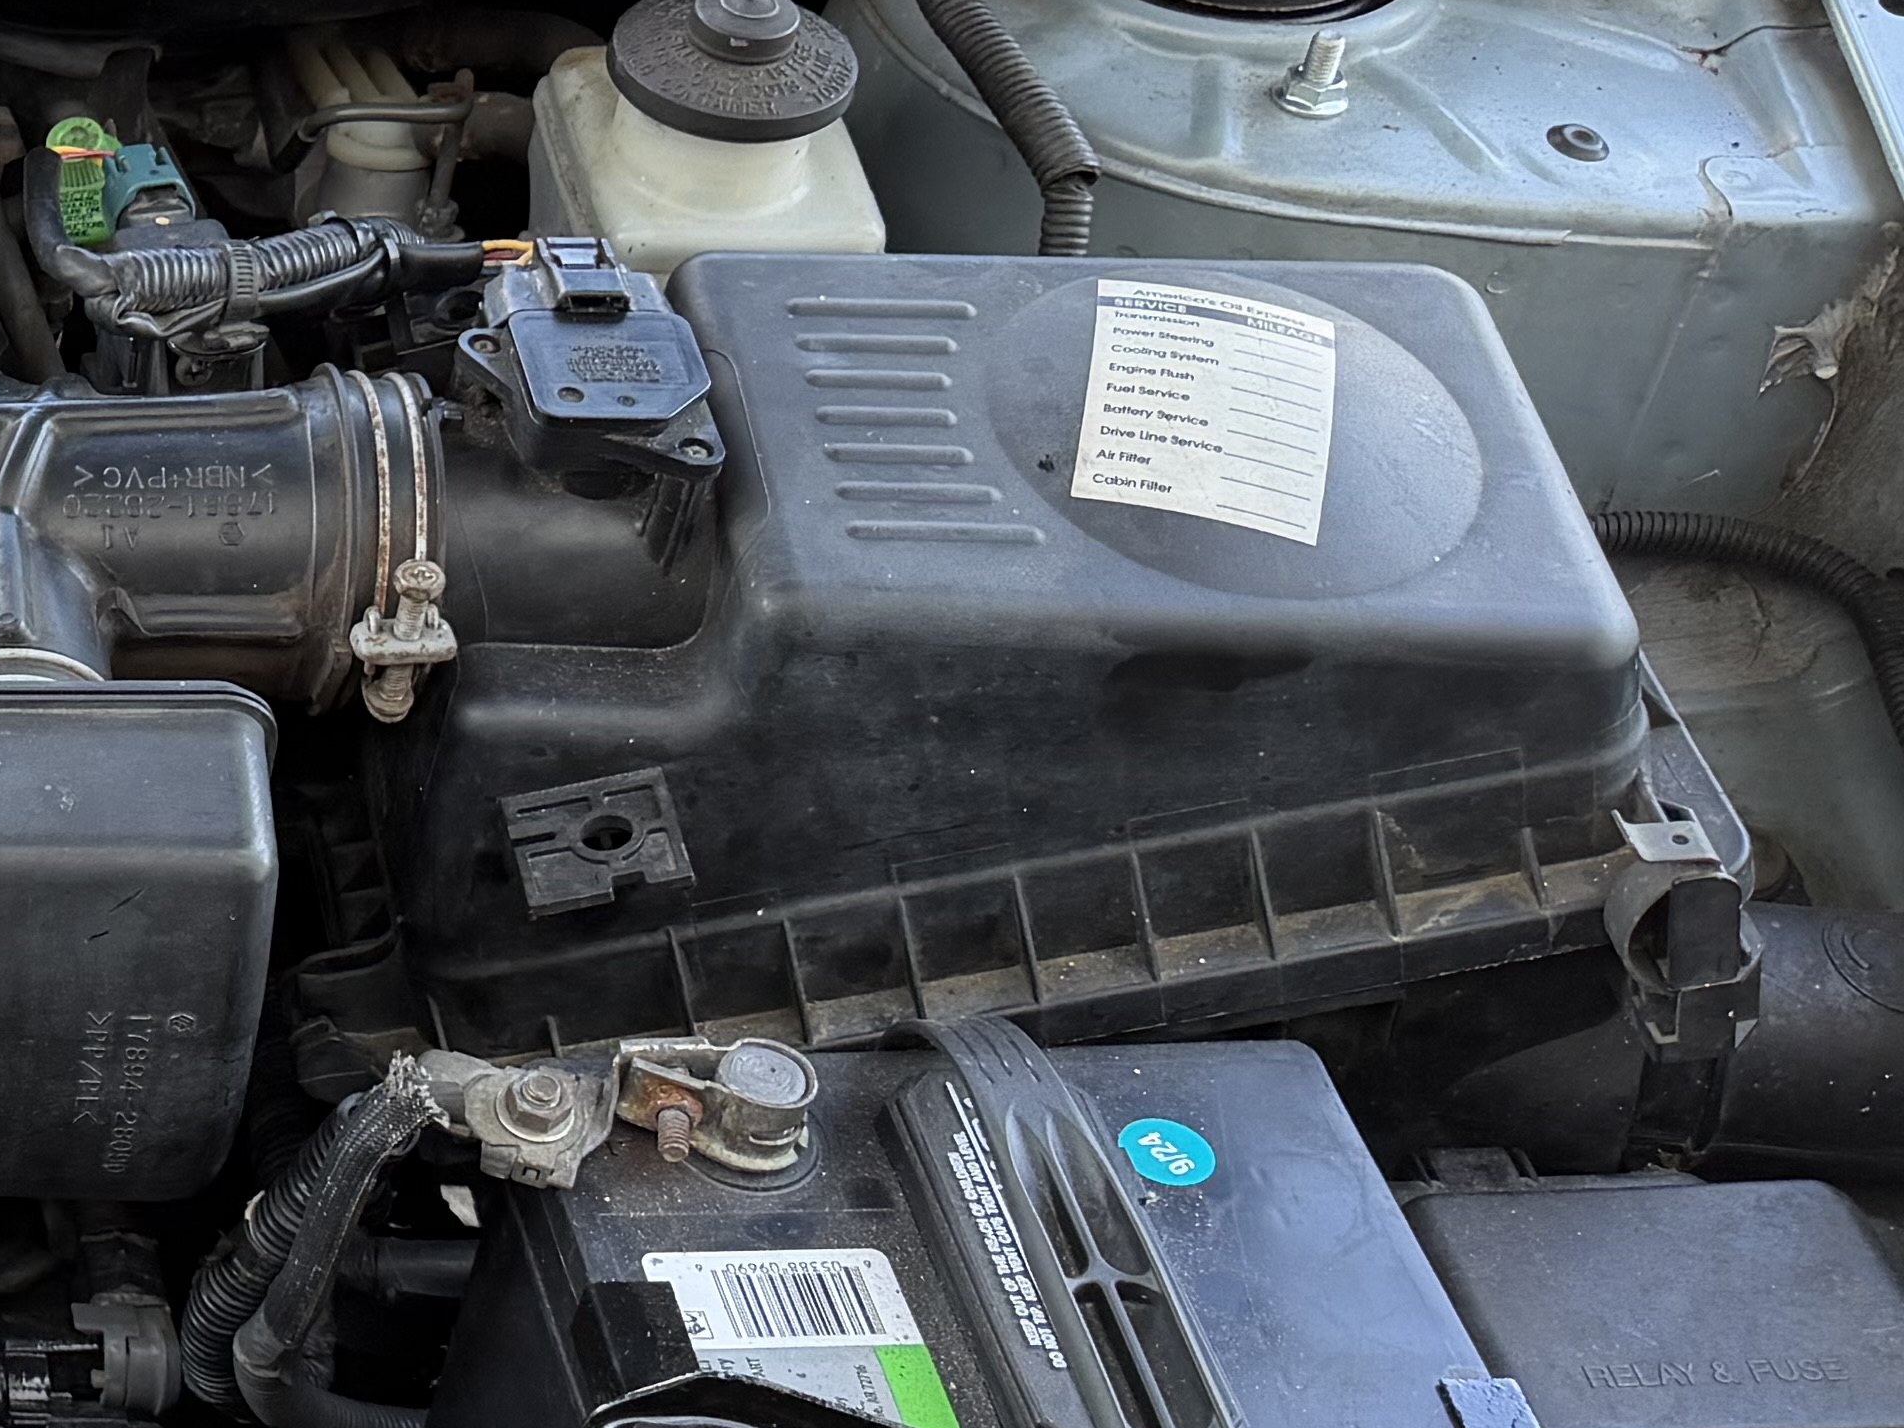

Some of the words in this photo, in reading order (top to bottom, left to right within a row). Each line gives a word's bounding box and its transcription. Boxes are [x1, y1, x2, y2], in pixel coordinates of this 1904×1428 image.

[1114, 298, 1187, 315] SERVICE
[1246, 317, 1327, 345] MILEAGE
[1112, 326, 1156, 341] Power
[1158, 331, 1215, 349] Steering
[1110, 343, 1167, 361] Cooling
[1169, 350, 1220, 367] System
[1108, 362, 1157, 379] Engine
[1160, 366, 1195, 382] Flush
[1106, 382, 1135, 397] Fuel
[1138, 384, 1191, 402] Service
[1103, 403, 1154, 421] Battery
[1157, 409, 1209, 428] Service
[1100, 425, 1137, 442] Drive
[1139, 430, 1167, 446] Line
[1170, 434, 1223, 454] Service
[1096, 448, 1117, 463] Air
[1119, 450, 1152, 466] Filter
[1092, 471, 1137, 489] Cabin
[1139, 476, 1172, 495] Filter
[1138, 1132, 1198, 1179] 9/24
[976, 1214, 1001, 1254] REACH
[991, 1251, 1010, 1276] THE
[1001, 1276, 1018, 1292] OF
[1016, 1275, 1037, 1302] KEEP
[1010, 1294, 1028, 1317] OUT
[1020, 1318, 1042, 1346] KEEP
[1039, 1325, 1057, 1350] NOT
[1048, 1348, 1067, 1369] DO
[1582, 1363, 1696, 1390] RELAY
[1710, 1360, 1741, 1385] &
[1747, 1356, 1852, 1383] FUSE
